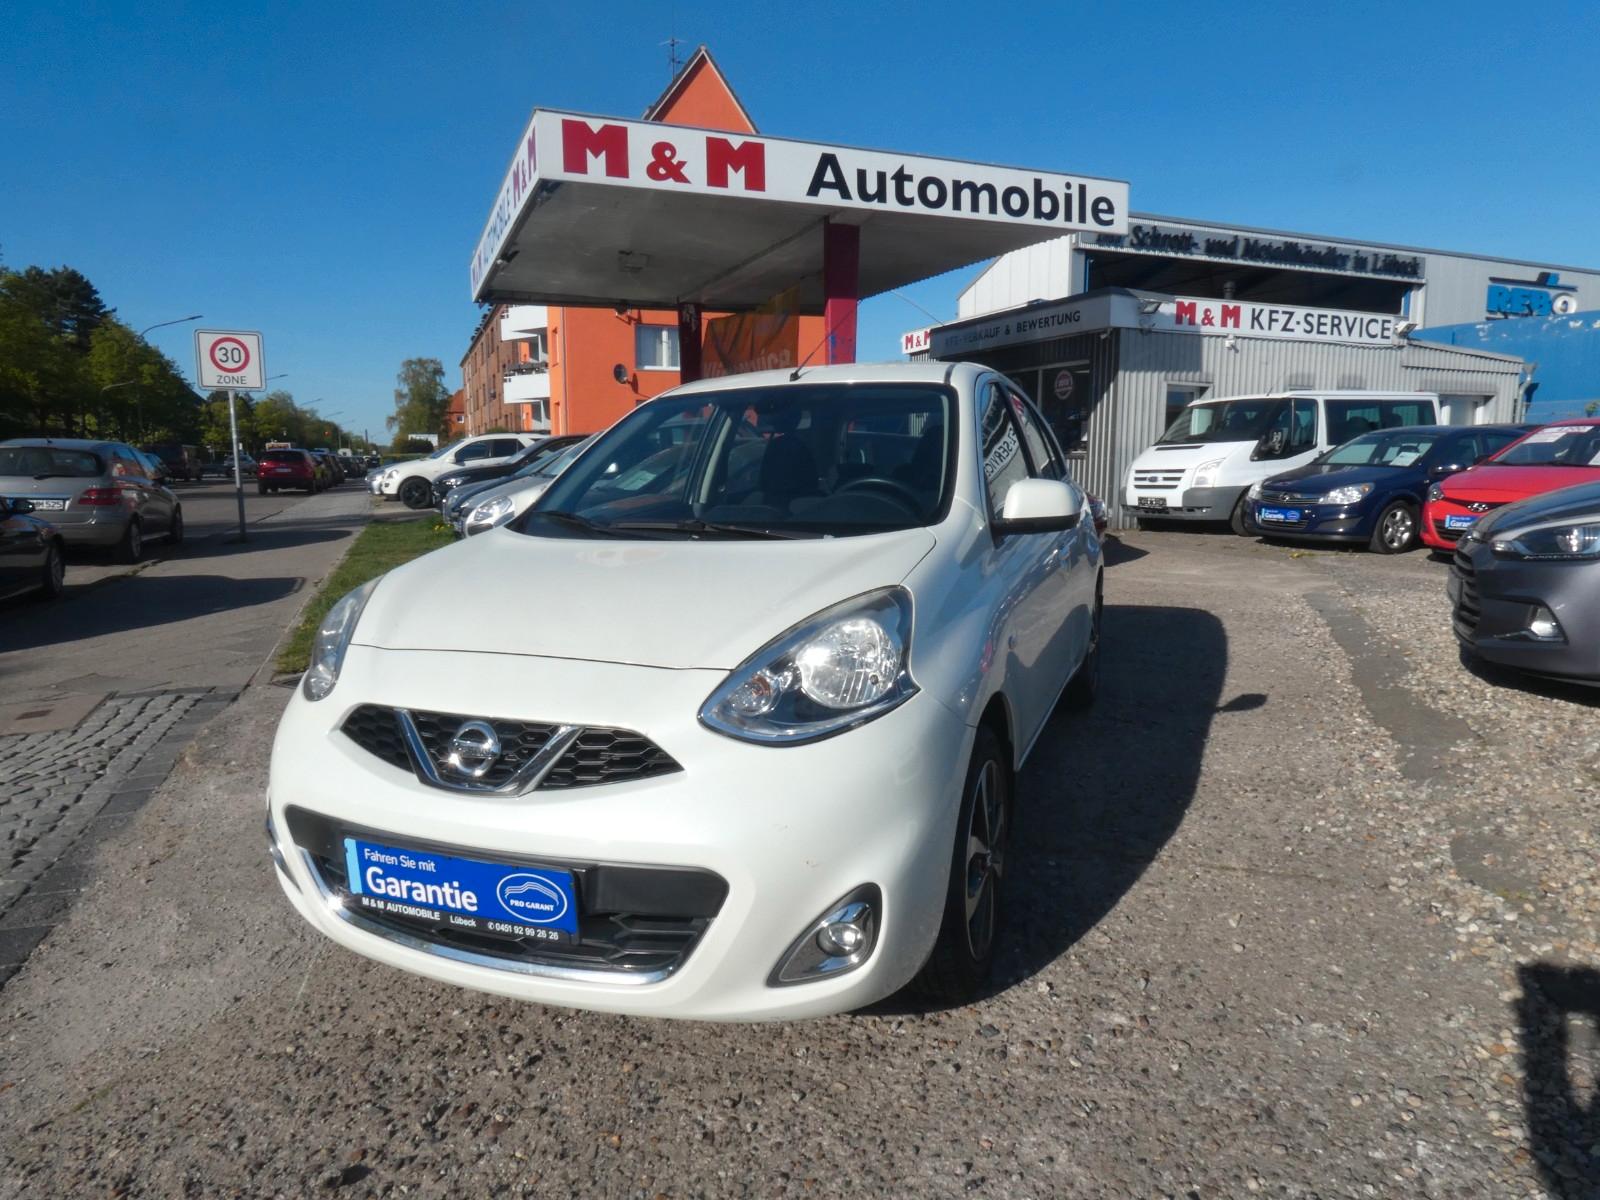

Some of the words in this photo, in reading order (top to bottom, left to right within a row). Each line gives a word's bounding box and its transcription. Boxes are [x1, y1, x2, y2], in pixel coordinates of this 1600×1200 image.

[513, 161, 520, 208] M
[528, 125, 537, 182] M
[562, 119, 629, 178] M
[646, 142, 691, 184] &
[706, 136, 765, 192] M
[806, 152, 1115, 226] Automobile
[1005, 325, 1011, 336] &
[1016, 310, 1081, 333] BEWERTUNG
[1175, 301, 1196, 326] M
[1201, 308, 1214, 326] &
[1221, 304, 1241, 328] M
[218, 346, 242, 363] 30
[905, 334, 913, 350] M
[915, 338, 921, 347] &
[216, 375, 247, 385] ZONE
[364, 848, 398, 866] Fahren
[400, 855, 416, 869] Sie
[418, 860, 436, 872] mit
[366, 866, 478, 911] Garantie
[362, 896, 369, 906] M
[370, 899, 377, 908] &
[377, 900, 385, 909] M
[386, 902, 441, 920] AUTOMOBILE
[450, 914, 476, 927] Lübeck
[495, 921, 512, 933] 0451
[514, 925, 524, 935] 92
[510, 899, 524, 908] PRO
[525, 901, 555, 912] GARANT
